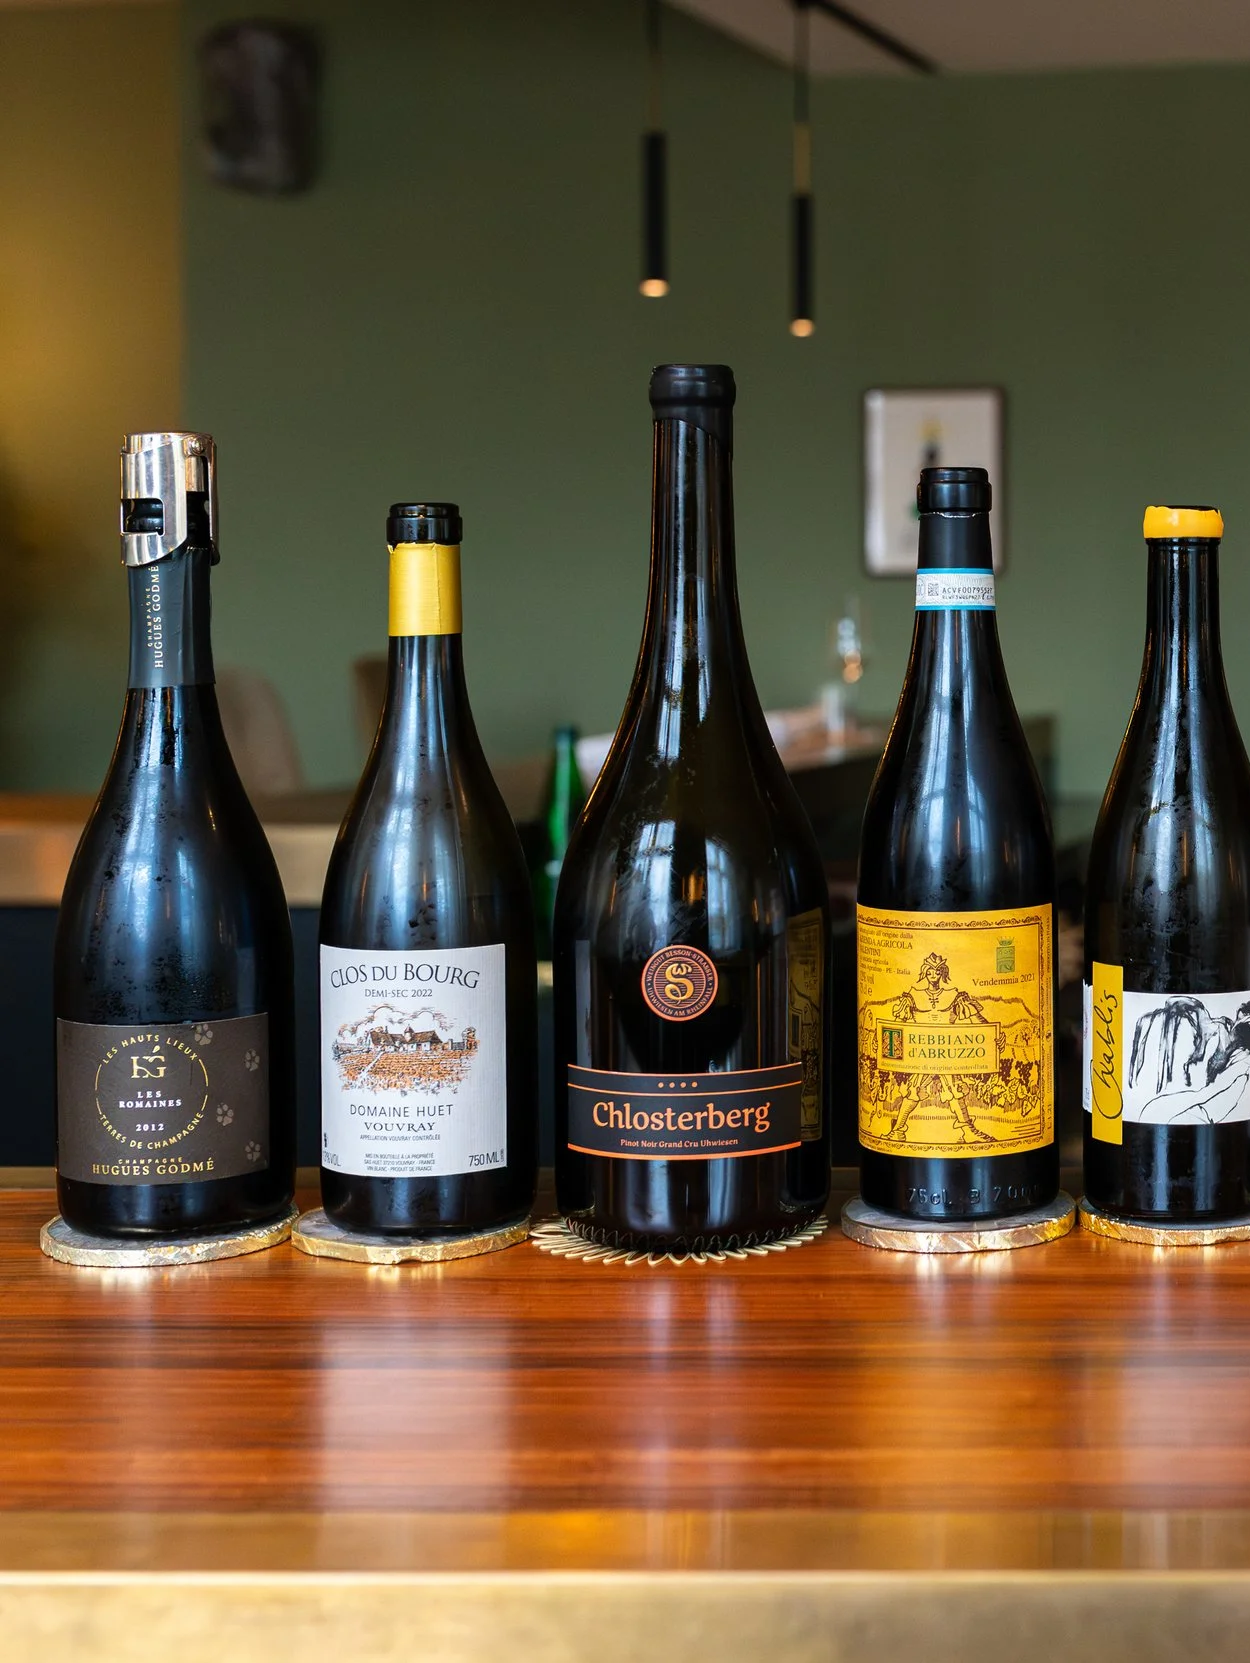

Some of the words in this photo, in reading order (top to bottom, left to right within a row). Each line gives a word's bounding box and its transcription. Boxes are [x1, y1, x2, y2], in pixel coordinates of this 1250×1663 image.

[153, 616, 163, 668] HUGUES
[877, 940, 912, 949] AGRICOLA
[331, 965, 367, 988] CLOS
[372, 966, 397, 981] DU
[404, 963, 480, 989] BOURG
[972, 976, 1018, 986] Vendemmia
[1021, 974, 1035, 982] 2021
[364, 989, 408, 997] DEMI-SEC
[412, 989, 432, 997] 2022
[102, 1048, 118, 1064] LES
[121, 1034, 159, 1047] HAUTS
[167, 1038, 197, 1061] LIEUX
[909, 1048, 985, 1058] d'ABRUZZO
[1090, 990, 1123, 1119] Chablis
[119, 1100, 181, 1108] ROMAINES
[350, 1104, 410, 1117] DOMAINE
[417, 1105, 453, 1116] HUET
[593, 1102, 770, 1132] Chlosterberg
[100, 1114, 126, 1143] TERRES
[130, 1140, 142, 1149] DE
[147, 1112, 203, 1149] CHAMPAGNE
[364, 1122, 435, 1132] VOUVRAY
[621, 1139, 639, 1147] Pinot
[469, 1153, 485, 1167] 750
[486, 1151, 499, 1164] ML
[93, 1164, 149, 1175] HUGUES
[157, 1158, 214, 1175] GODMÉ
